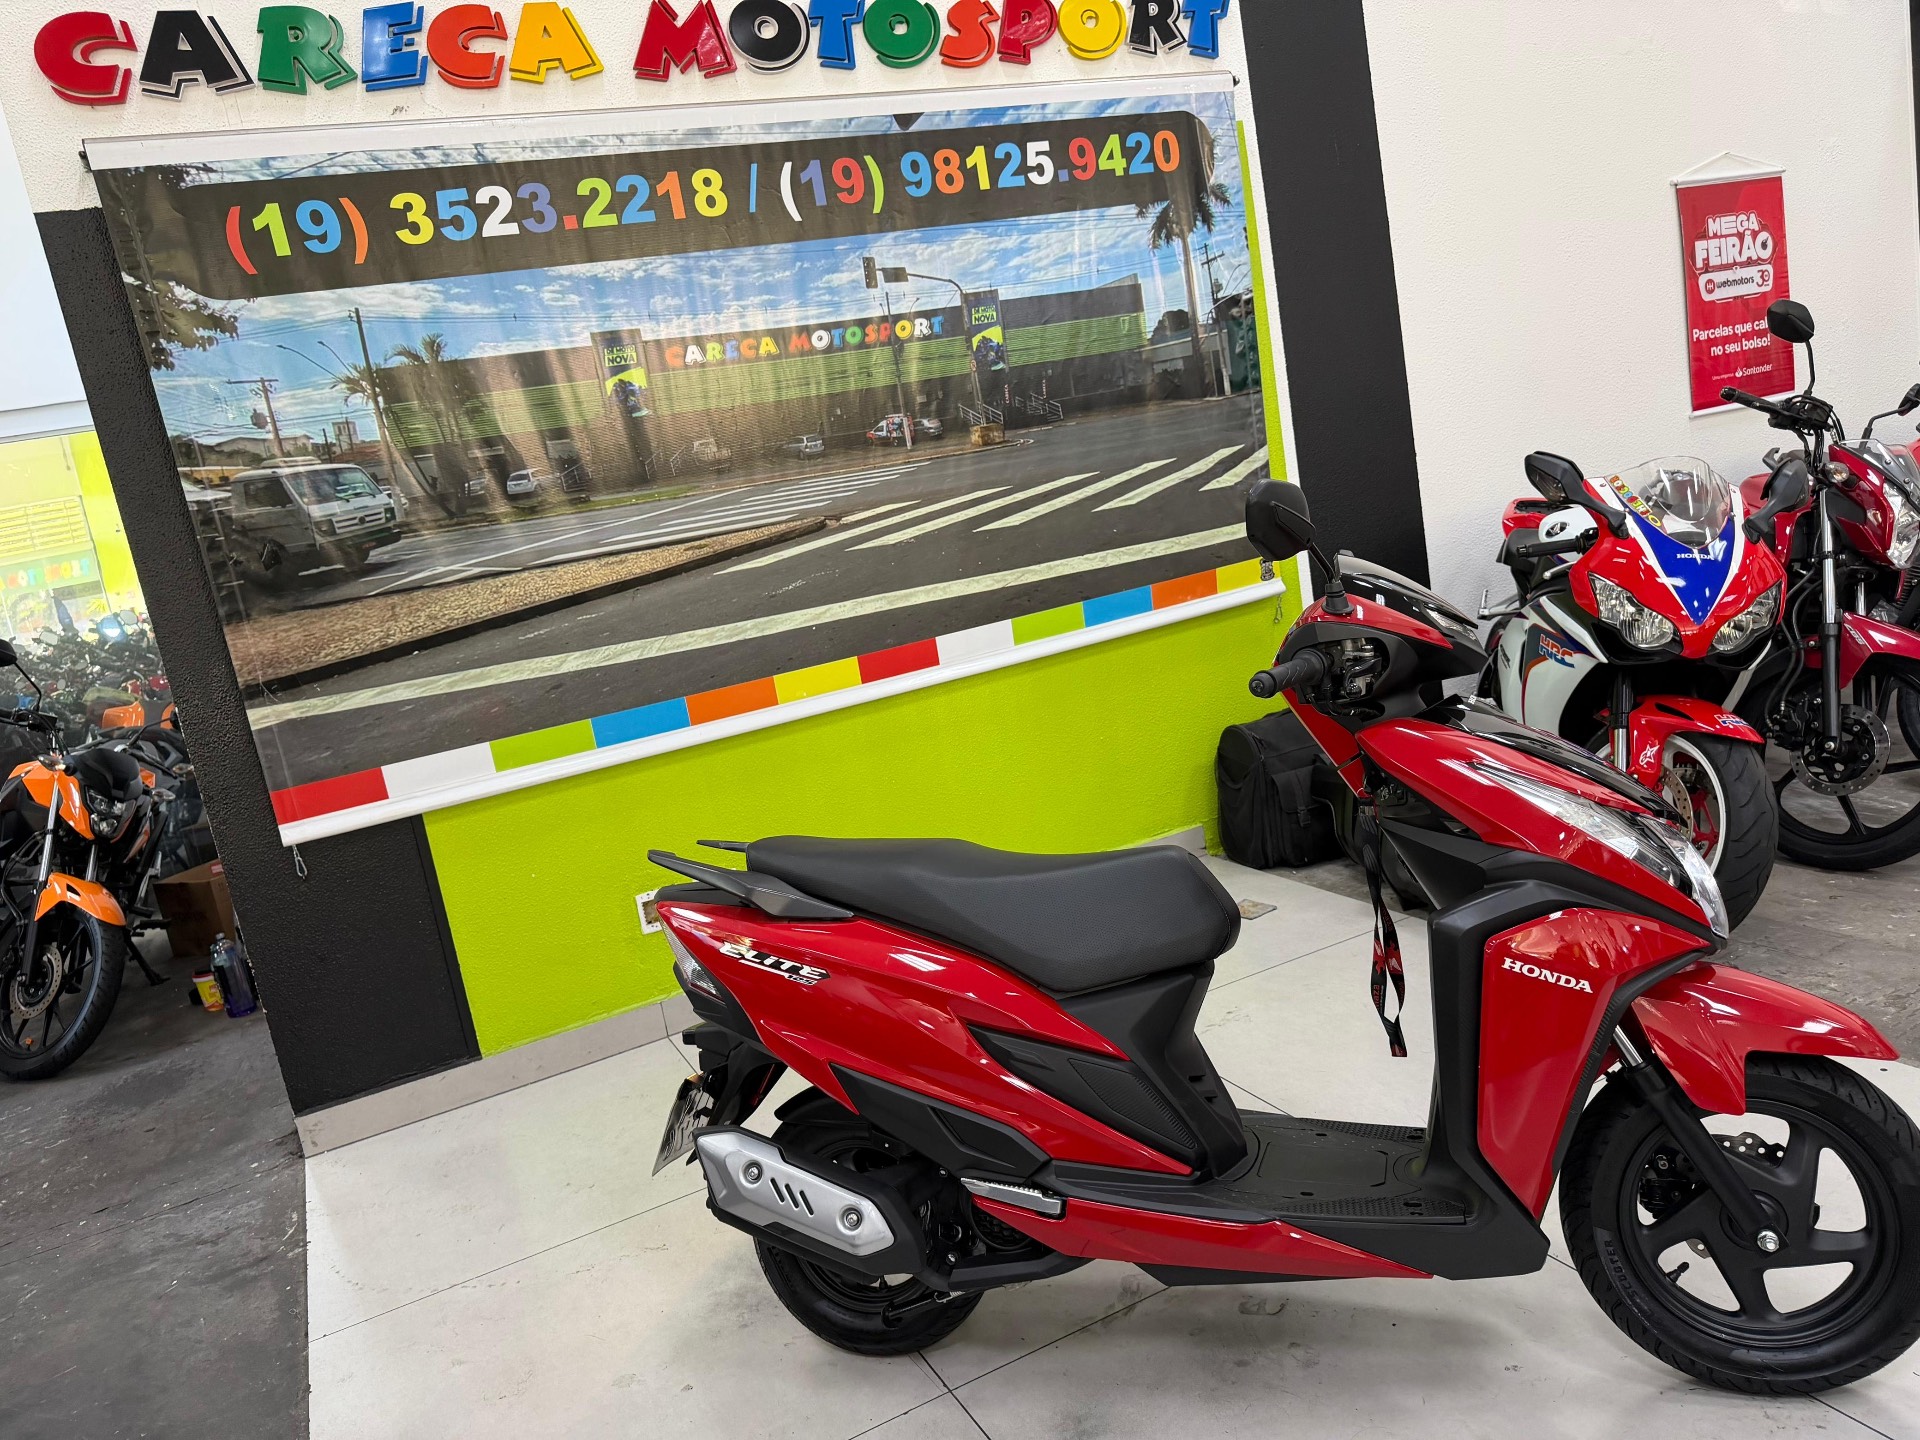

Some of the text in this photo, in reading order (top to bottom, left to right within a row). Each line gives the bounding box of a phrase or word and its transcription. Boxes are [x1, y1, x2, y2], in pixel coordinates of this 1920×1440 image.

[33, 0, 1230, 106] CARECA MOTOSPORT
[224, 129, 1182, 276] (19) 3523.2218 / (19) 98125.9420
[1707, 212, 1760, 237] MEGA
[1694, 230, 1773, 269] FEIRÃO
[1715, 275, 1755, 289] webmotors
[973, 313, 996, 324] NOVA
[664, 315, 946, 367] CARECA MOTOSPORT
[1692, 323, 1734, 342] Parcelas
[1734, 321, 1753, 337] que
[1710, 333, 1772, 357] no seu bolso!
[606, 353, 637, 366] NOVA
[1742, 363, 1773, 377] Santander
[1676, 553, 1715, 561] HONDA
[1538, 633, 1576, 669] HRC
[719, 941, 828, 980] ELITE
[1500, 956, 1594, 994] HONDA
